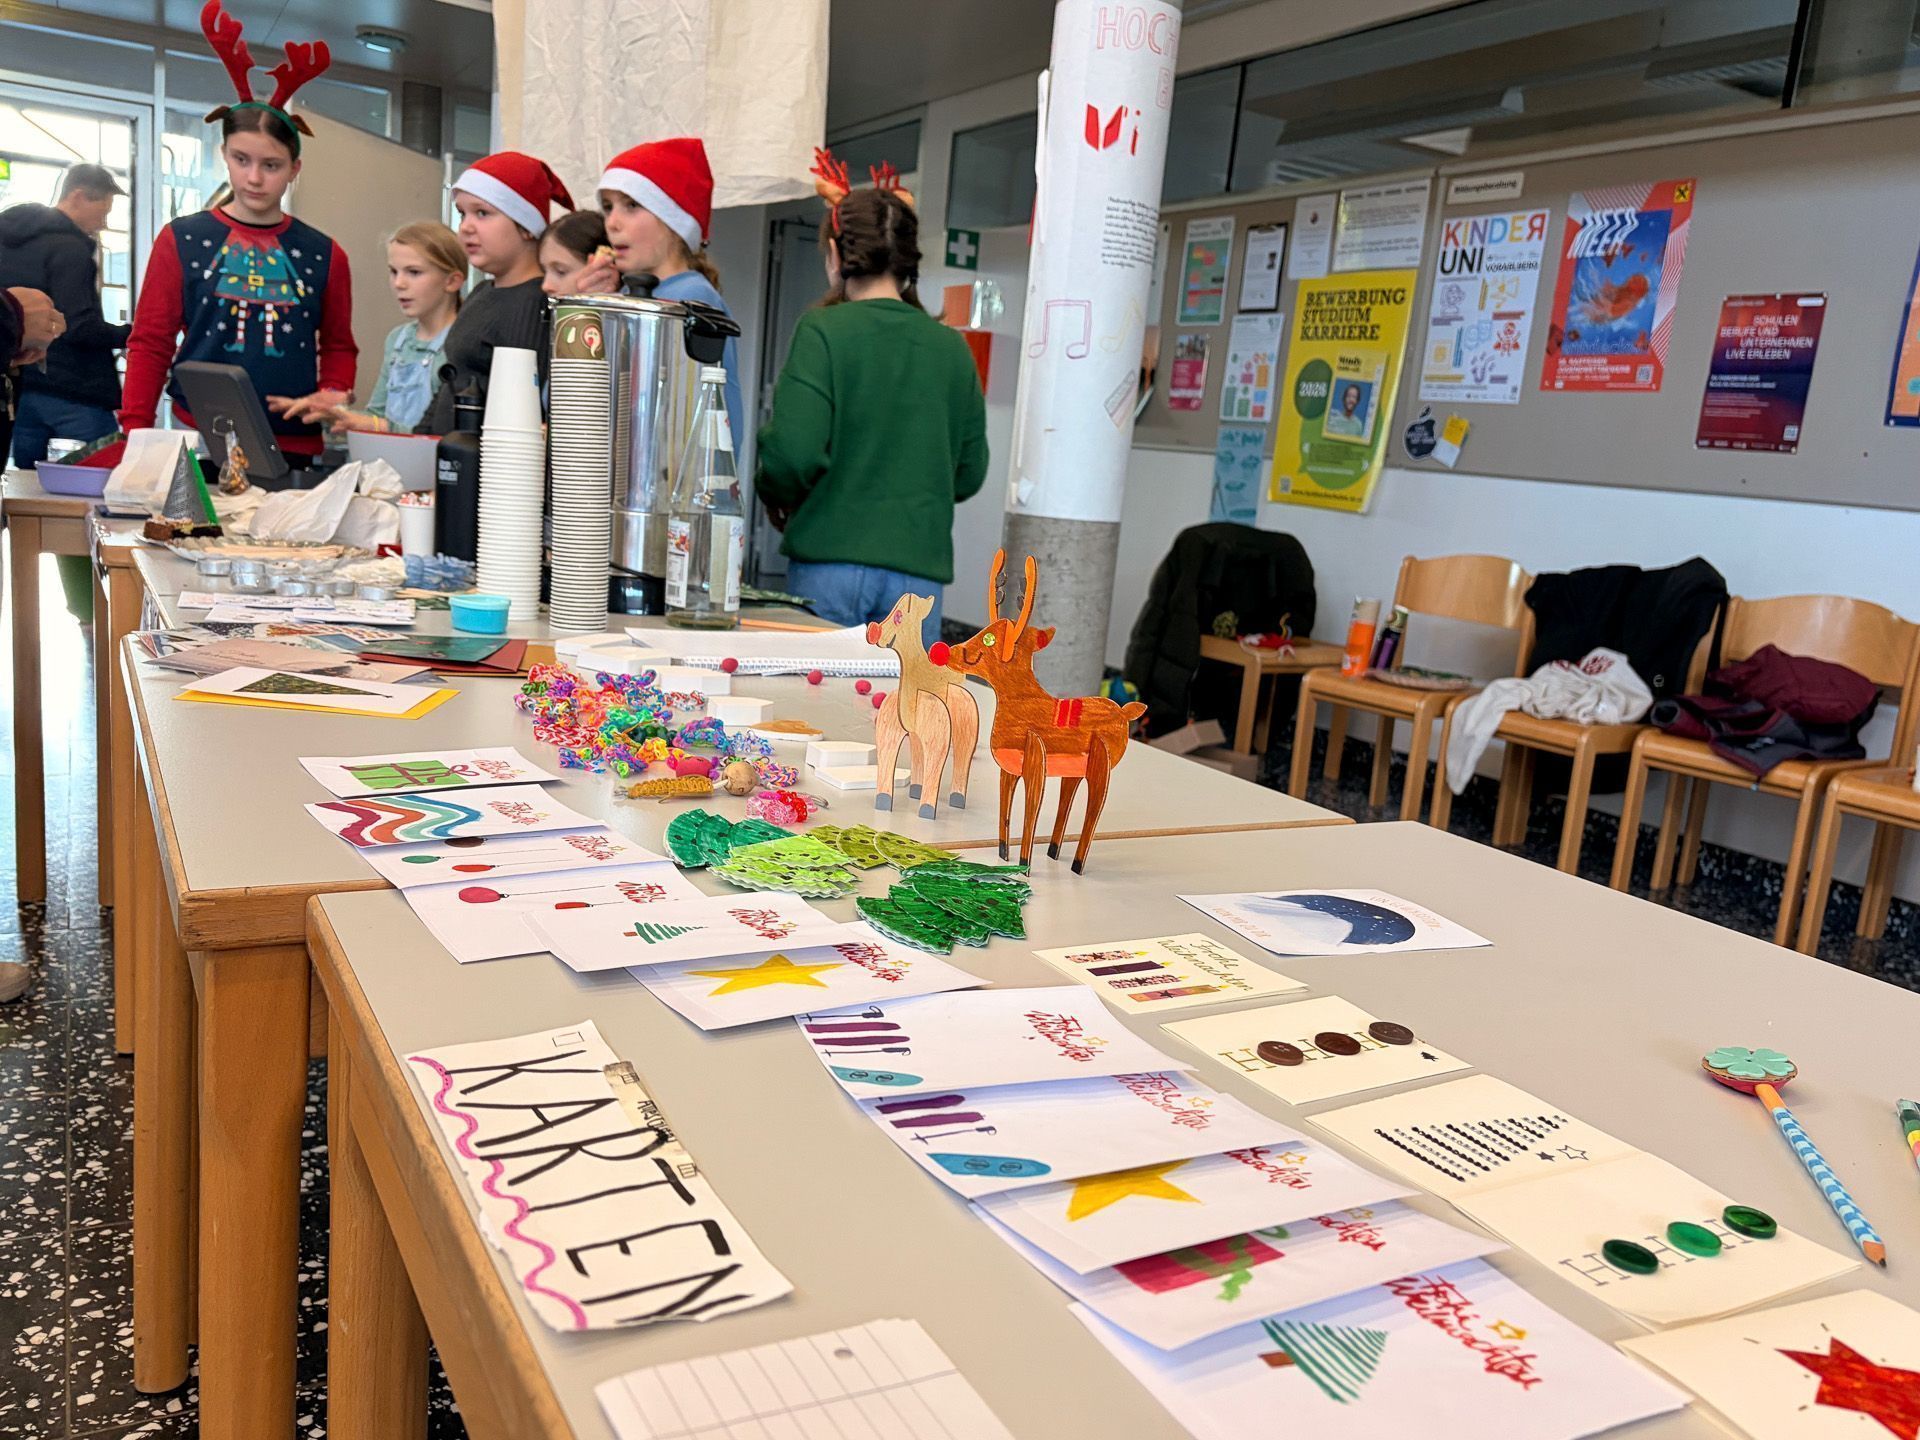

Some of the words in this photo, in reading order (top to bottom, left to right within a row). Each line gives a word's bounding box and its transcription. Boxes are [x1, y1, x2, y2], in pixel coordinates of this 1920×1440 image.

[1440, 246, 1485, 275] UNI
[1305, 287, 1407, 307] BEWERBUNG
[1302, 307, 1372, 324] STUDIUM
[1753, 314, 1799, 327] SCHULEN
[1300, 324, 1381, 341] KARRIERE
[1720, 326, 1756, 338] BERUFE
[1757, 326, 1780, 337] UND
[1739, 337, 1814, 349] UNTERNEHMEN
[1725, 349, 1746, 360] LIVE
[1746, 349, 1792, 361] ERLEBEN
[445, 1049, 755, 1324] KARTEN
